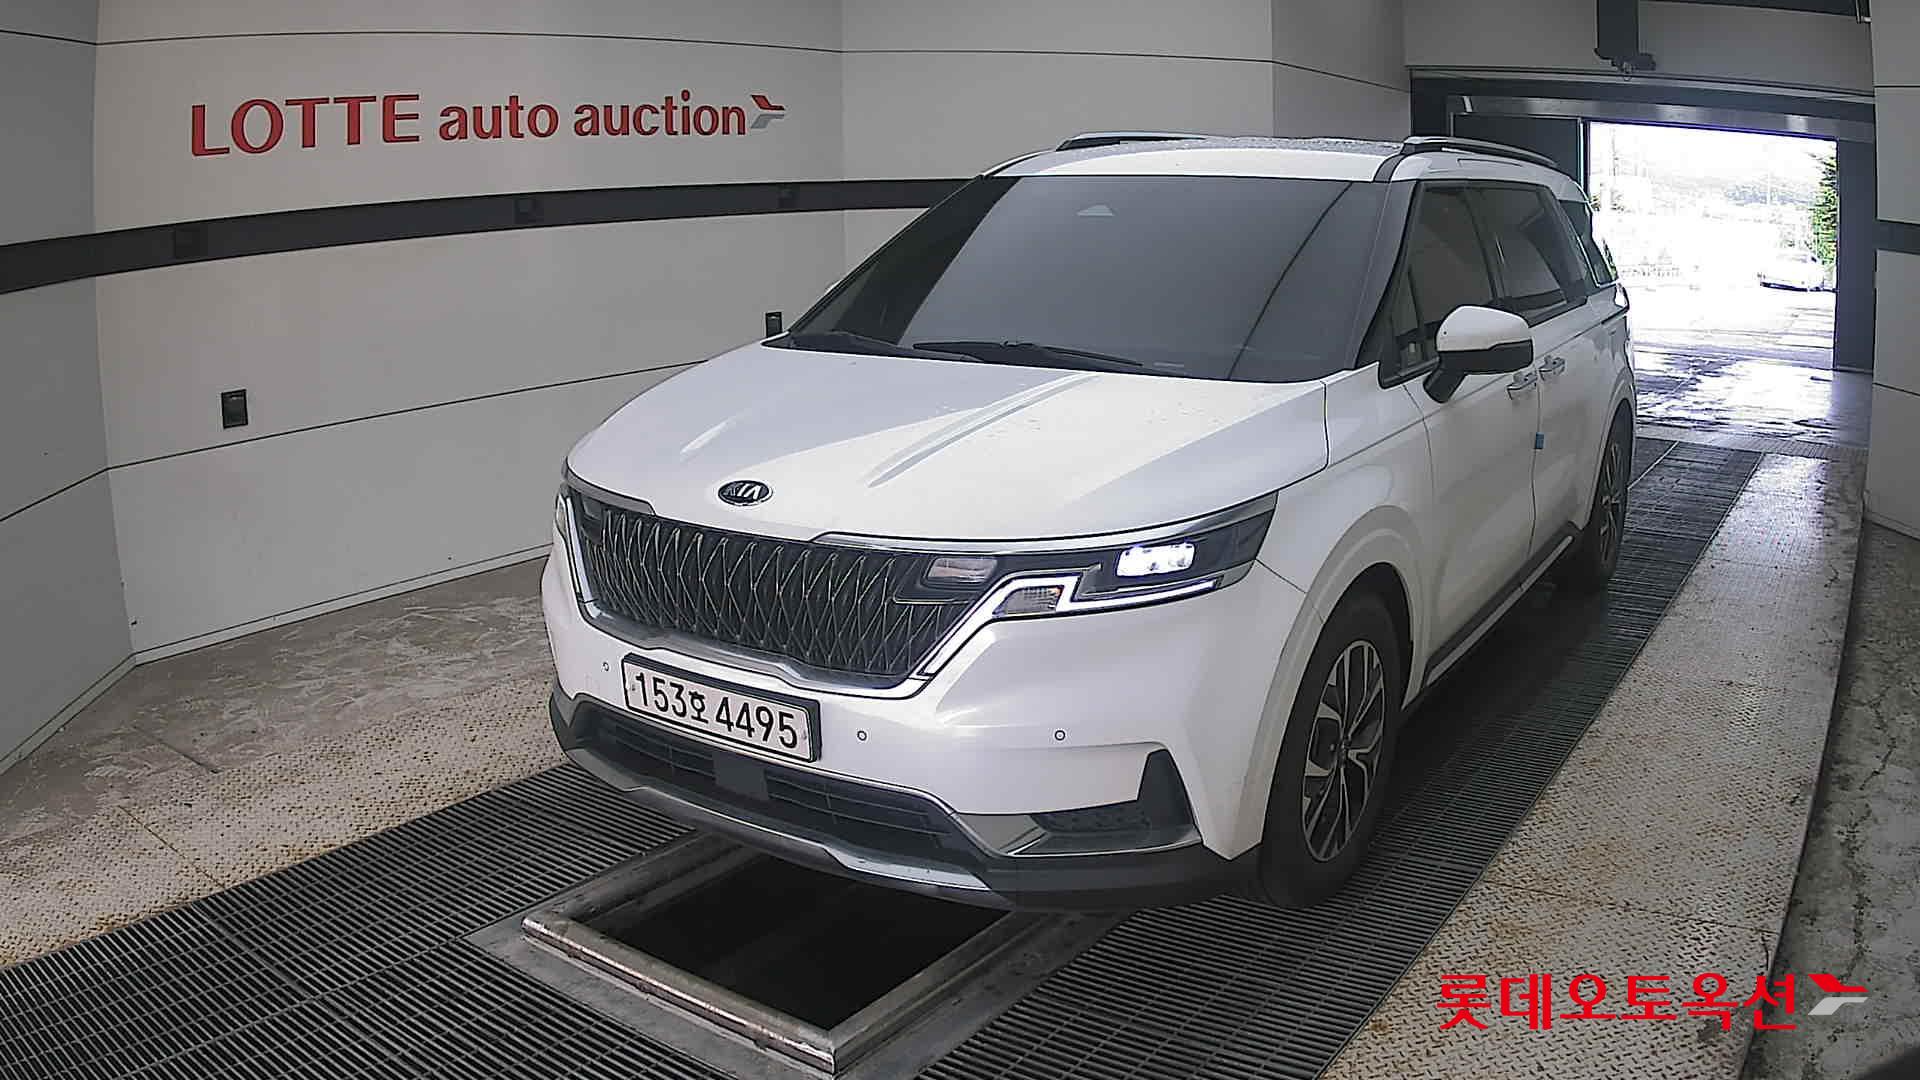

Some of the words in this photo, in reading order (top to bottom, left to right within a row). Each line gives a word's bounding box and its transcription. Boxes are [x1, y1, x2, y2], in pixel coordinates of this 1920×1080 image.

[191, 93, 420, 157] LOTTE
[438, 95, 560, 141] auto
[573, 89, 746, 137] auction
[720, 481, 763, 501] KIA
[715, 696, 798, 749] 4495
